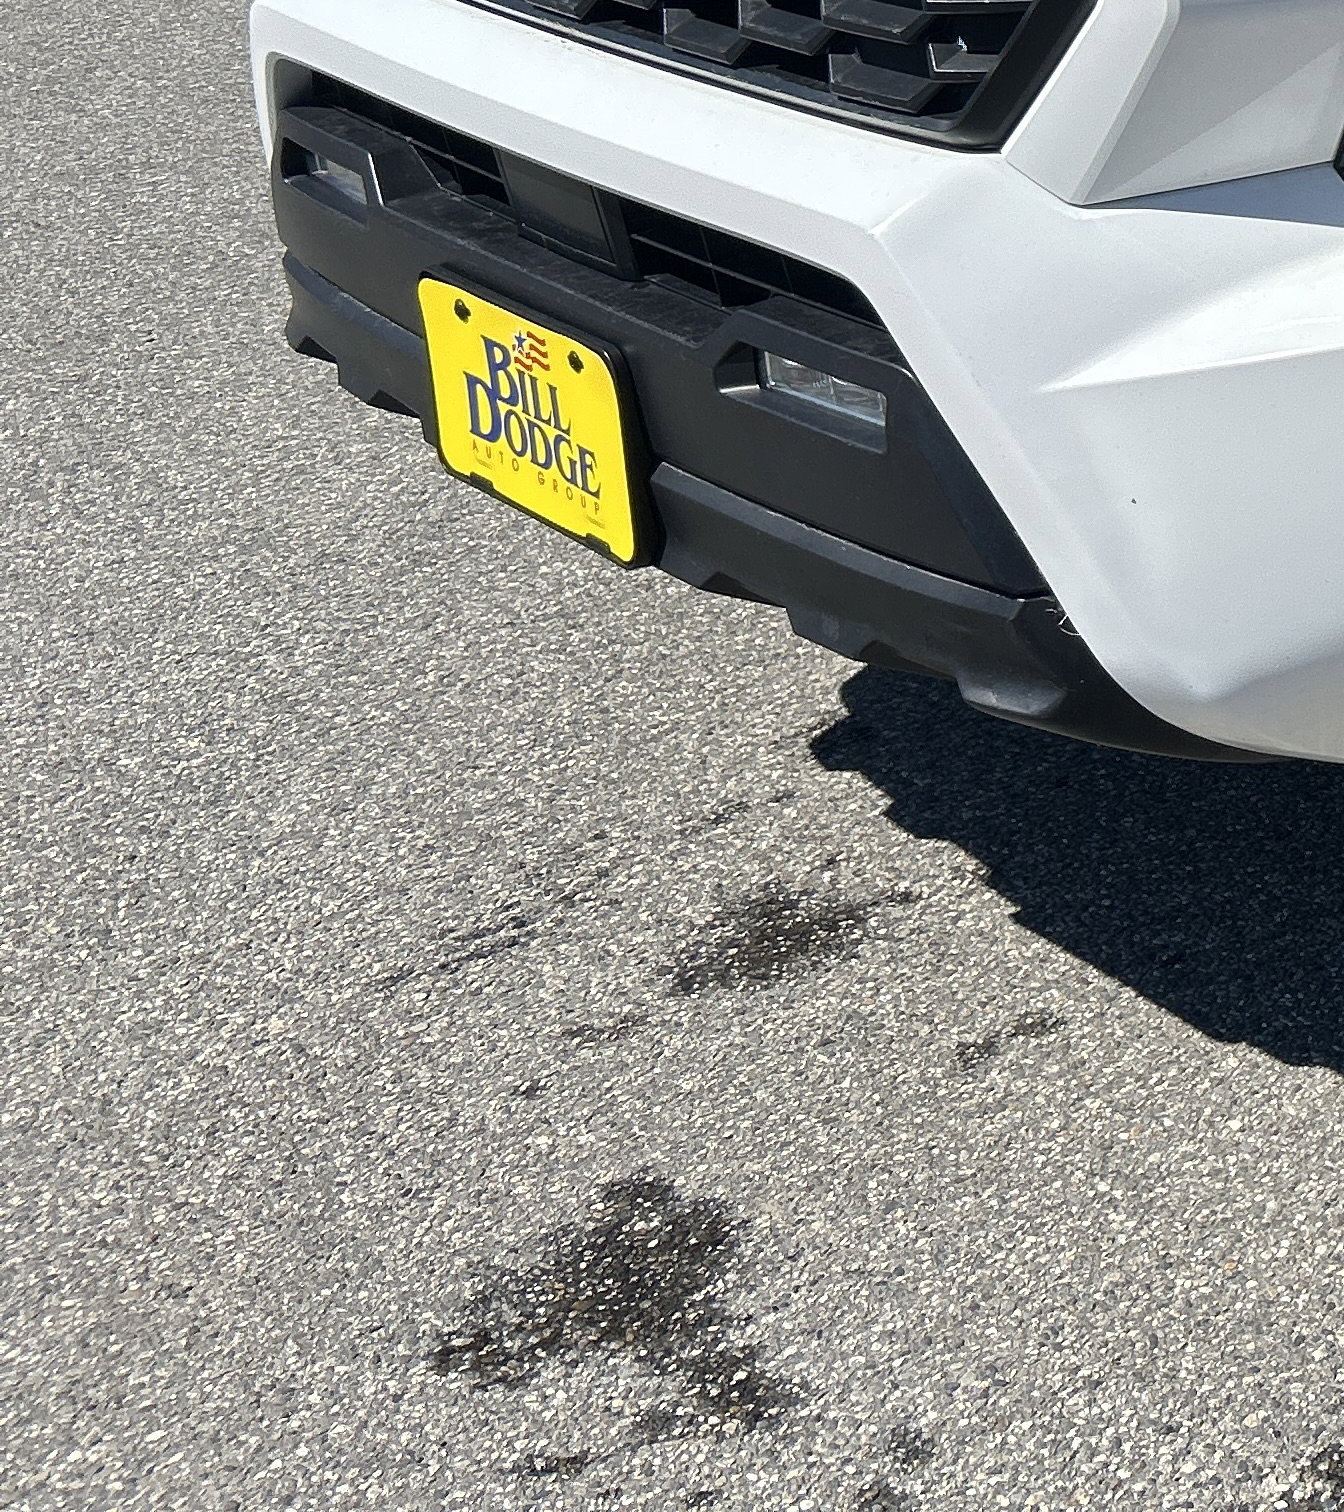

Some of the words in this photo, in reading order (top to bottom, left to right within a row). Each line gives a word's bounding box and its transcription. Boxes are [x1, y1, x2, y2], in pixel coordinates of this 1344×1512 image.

[462, 371, 602, 500] DODGE
[480, 334, 572, 437] BILL
[471, 439, 521, 473] AUTO
[536, 470, 601, 517] GROUP
